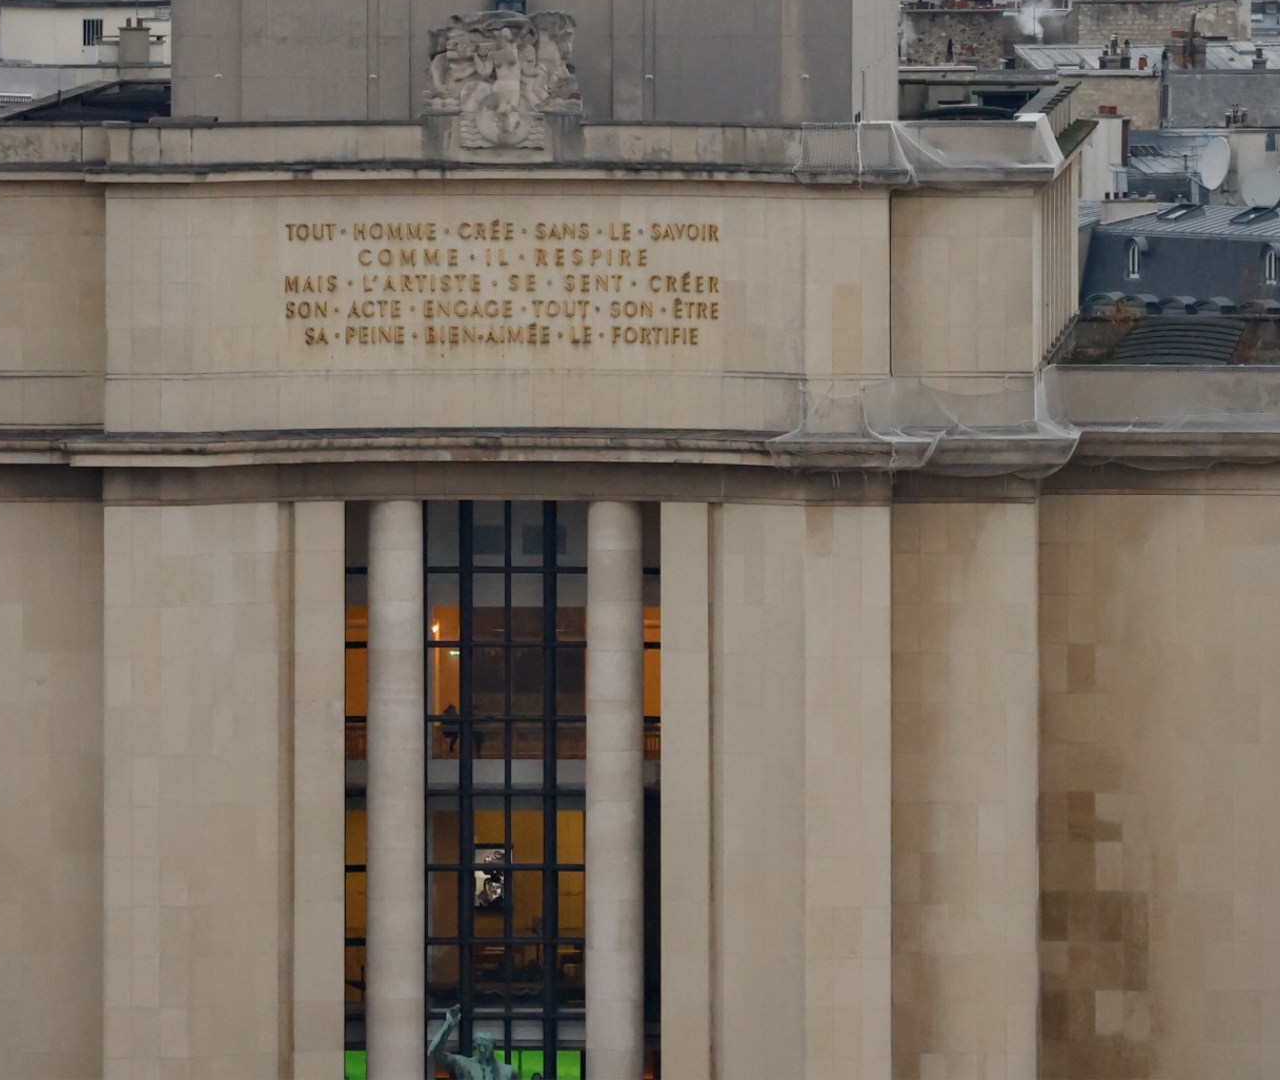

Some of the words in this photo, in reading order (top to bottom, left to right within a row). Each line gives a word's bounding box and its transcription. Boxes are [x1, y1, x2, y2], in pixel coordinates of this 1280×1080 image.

[285, 223, 337, 242] TOUT
[353, 222, 437, 241] HOMME
[457, 218, 514, 241] CRÉE
[535, 222, 590, 240] SANS
[609, 222, 631, 241] LE
[650, 223, 719, 242] SAVOIR
[358, 248, 458, 267] COMME
[485, 248, 509, 267] IL
[534, 248, 648, 267] RESPIRE
[284, 275, 338, 294] MAIS
[363, 274, 481, 293] L'ARTISTE
[508, 273, 536, 292] SE
[564, 273, 624, 292] SENT
[648, 271, 719, 293] CRÉER
[285, 300, 328, 319] SON
[347, 300, 401, 318] ACTE
[423, 299, 513, 318] ENGAGE
[532, 299, 590, 318] TOUT
[609, 300, 653, 318] SON
[673, 297, 719, 320] ÊTRE
[304, 326, 329, 345] SA
[345, 326, 405, 345] PEINE
[424, 322, 550, 345] BIEN-AIMÉE
[570, 326, 592, 345] LE
[611, 326, 699, 345] FORTIFIE
